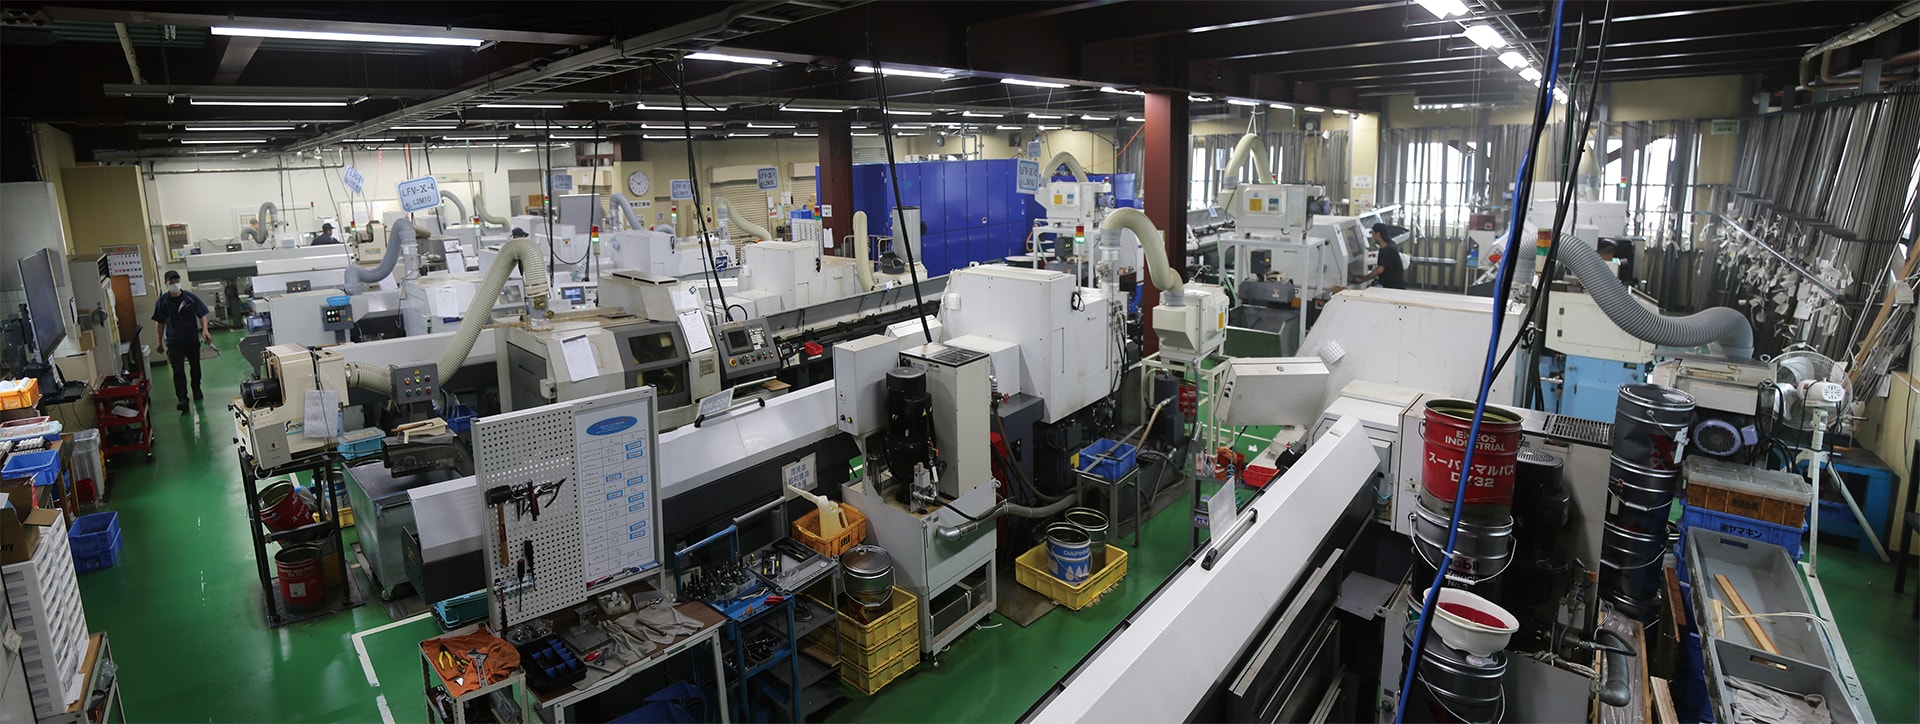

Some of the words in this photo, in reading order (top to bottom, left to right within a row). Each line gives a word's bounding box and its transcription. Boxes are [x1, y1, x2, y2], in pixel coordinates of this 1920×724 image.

[402, 183, 434, 197] LFV-X-4
[413, 196, 431, 205] L2M10
[1456, 430, 1496, 443] ENOS
[1449, 558, 1479, 572] obil
